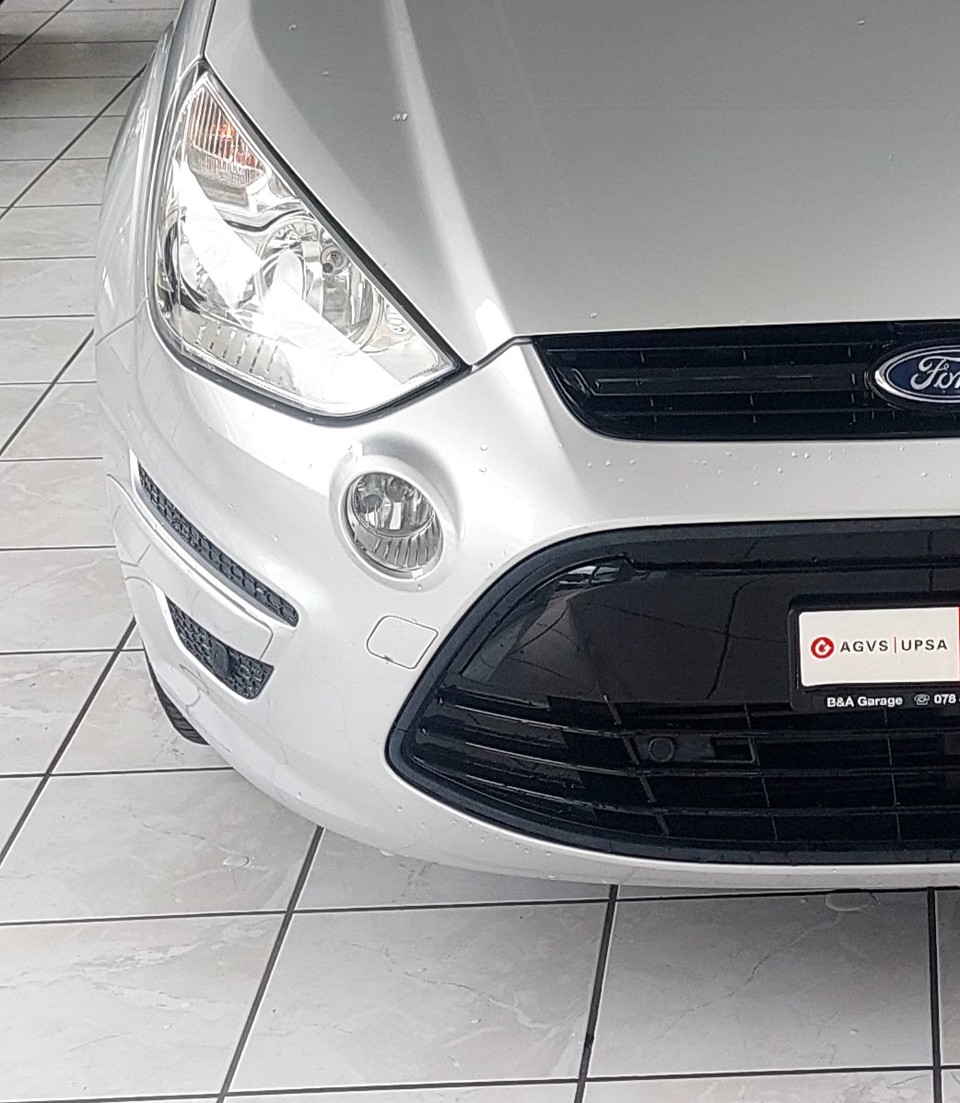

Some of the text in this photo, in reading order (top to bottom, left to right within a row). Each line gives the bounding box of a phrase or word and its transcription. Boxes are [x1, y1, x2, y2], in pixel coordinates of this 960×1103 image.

[840, 639, 948, 653] AGVS UPSA
[827, 697, 855, 707] B&A
[857, 696, 903, 707] Garage
[934, 694, 957, 705] 078
